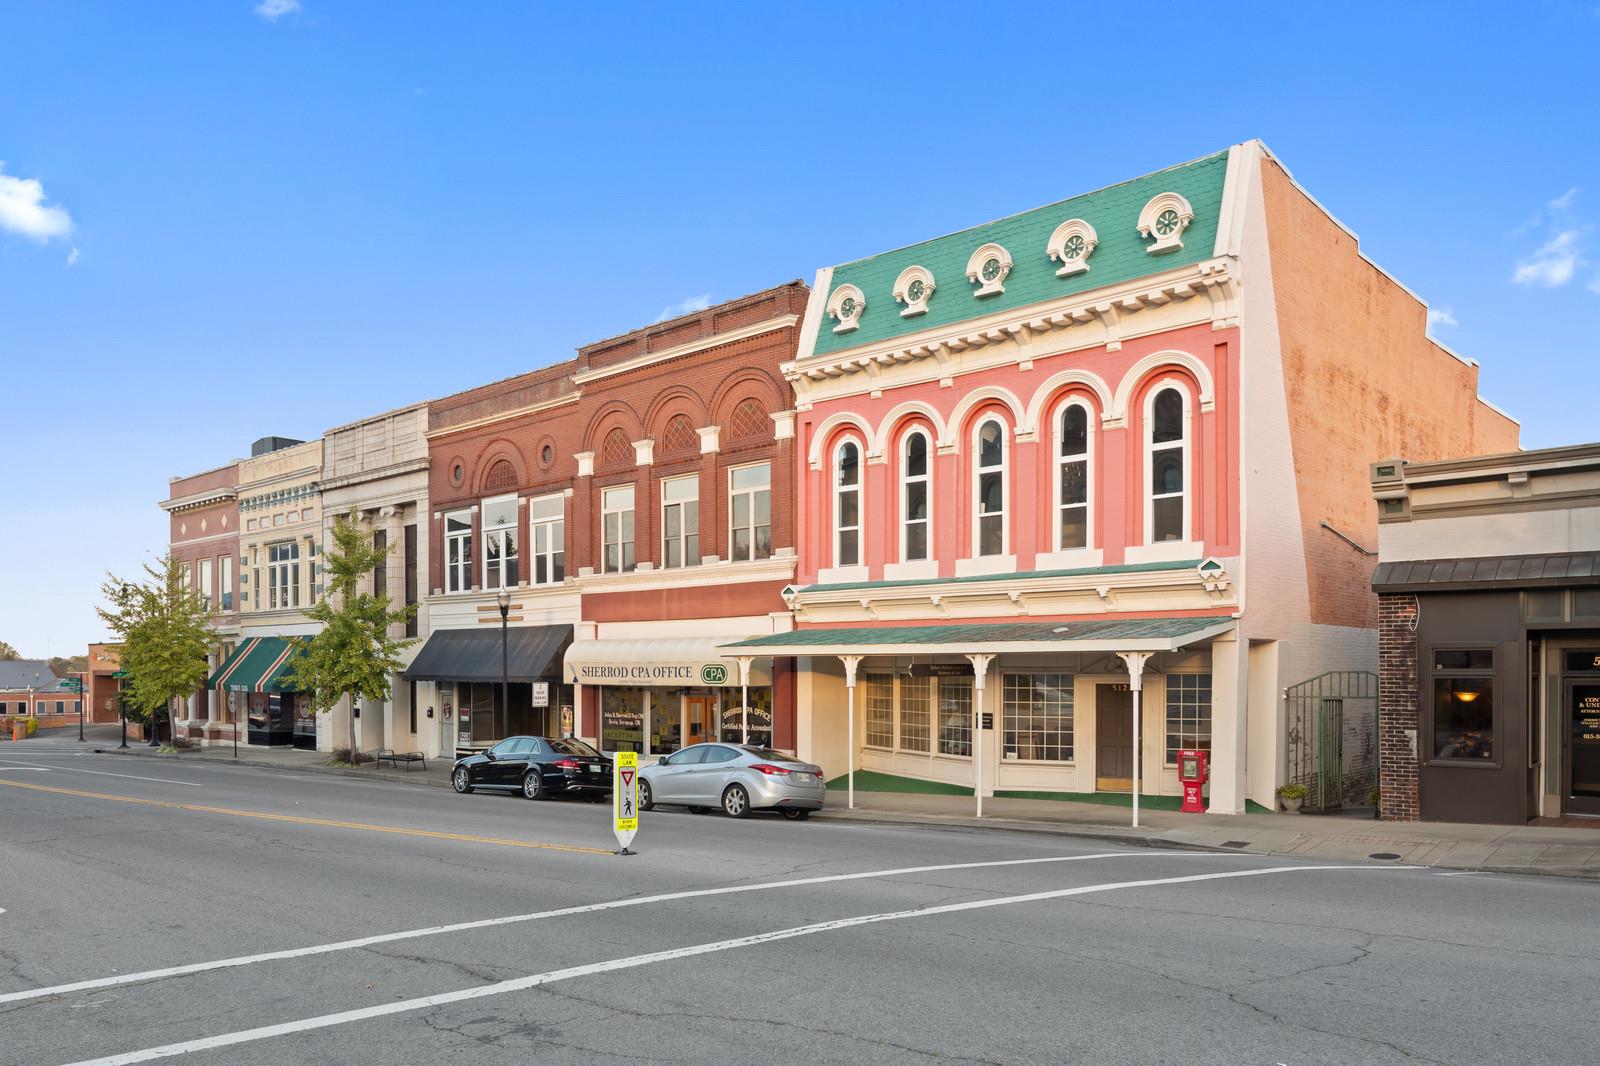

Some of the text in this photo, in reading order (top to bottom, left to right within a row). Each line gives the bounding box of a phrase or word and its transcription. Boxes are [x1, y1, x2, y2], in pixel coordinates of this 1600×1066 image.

[581, 666, 693, 678] SHERROD CPA OFFICE
[703, 668, 723, 681] CPA
[722, 706, 743, 720] SHERROD
[754, 707, 772, 722] OFFICE
